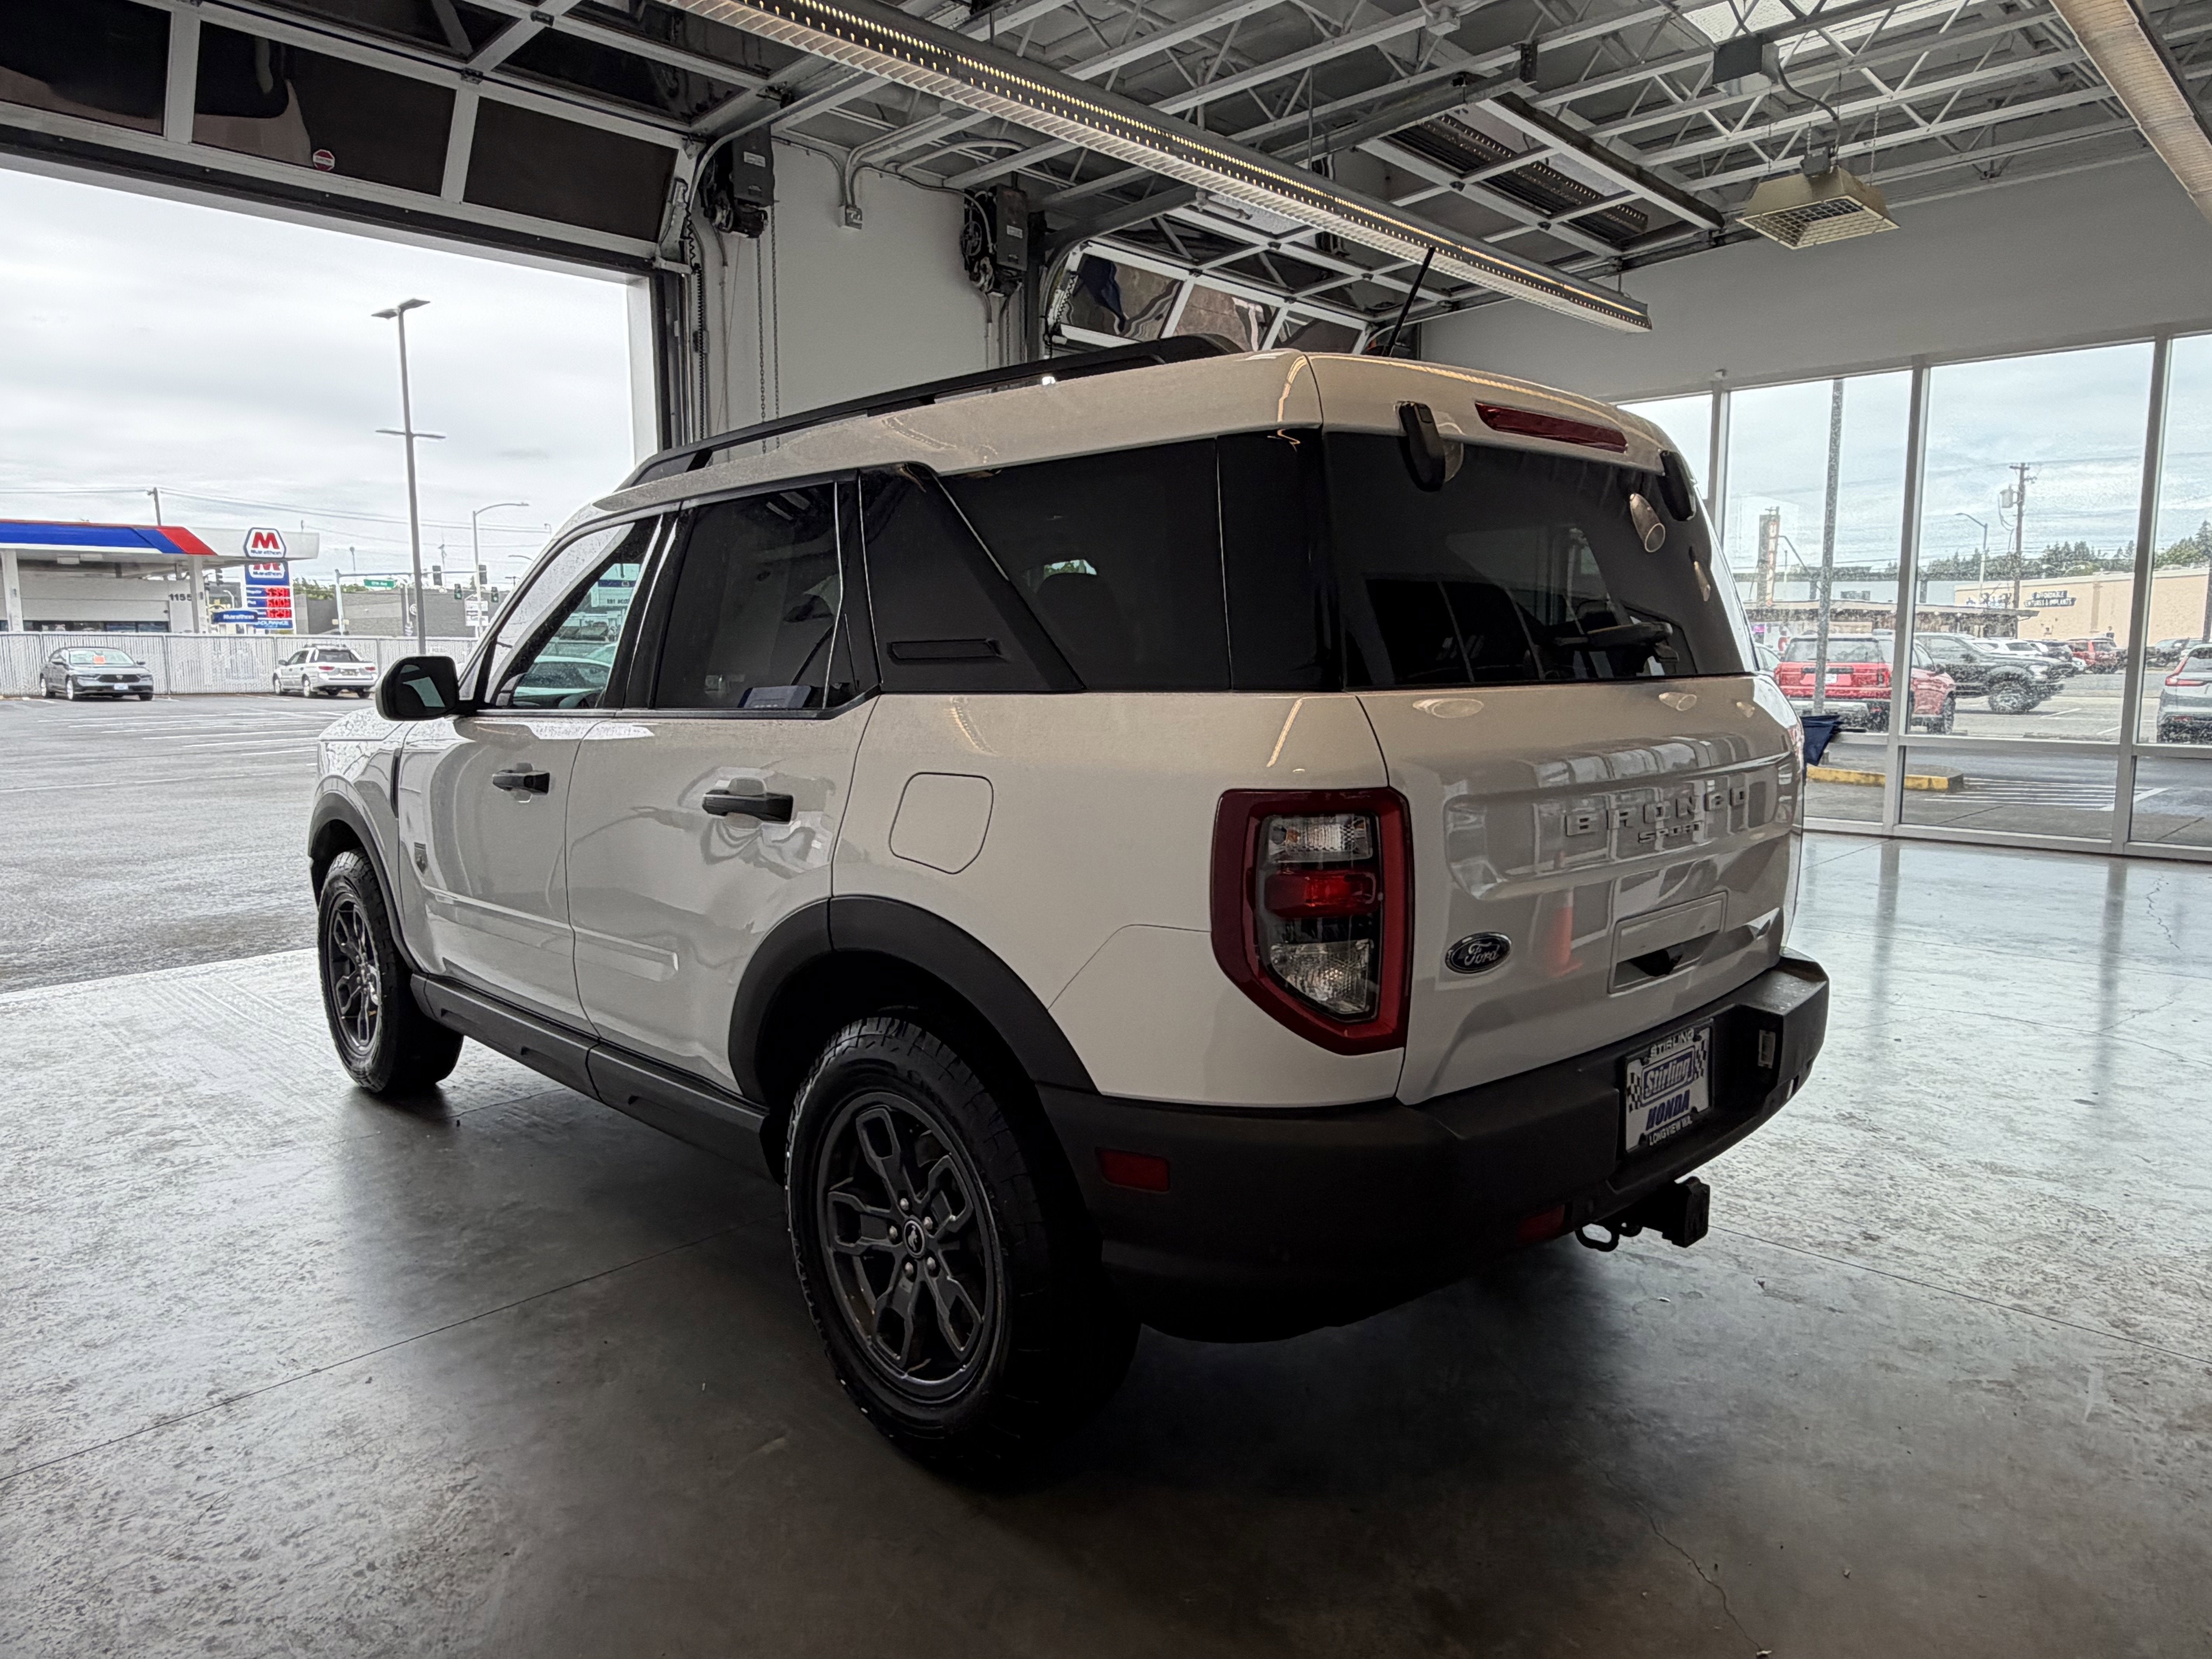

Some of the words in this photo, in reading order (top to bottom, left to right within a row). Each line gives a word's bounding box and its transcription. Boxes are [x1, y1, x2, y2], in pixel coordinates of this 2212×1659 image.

[252, 532, 280, 549] M
[1565, 786, 1746, 837] BRONCO
[1637, 821, 1702, 844] SPORT
[1464, 941, 1501, 966] Ford
[1650, 1027, 1695, 1058] STIRLING
[1645, 1059, 1691, 1097] Stirling
[1646, 1089, 1690, 1132] HONDA
